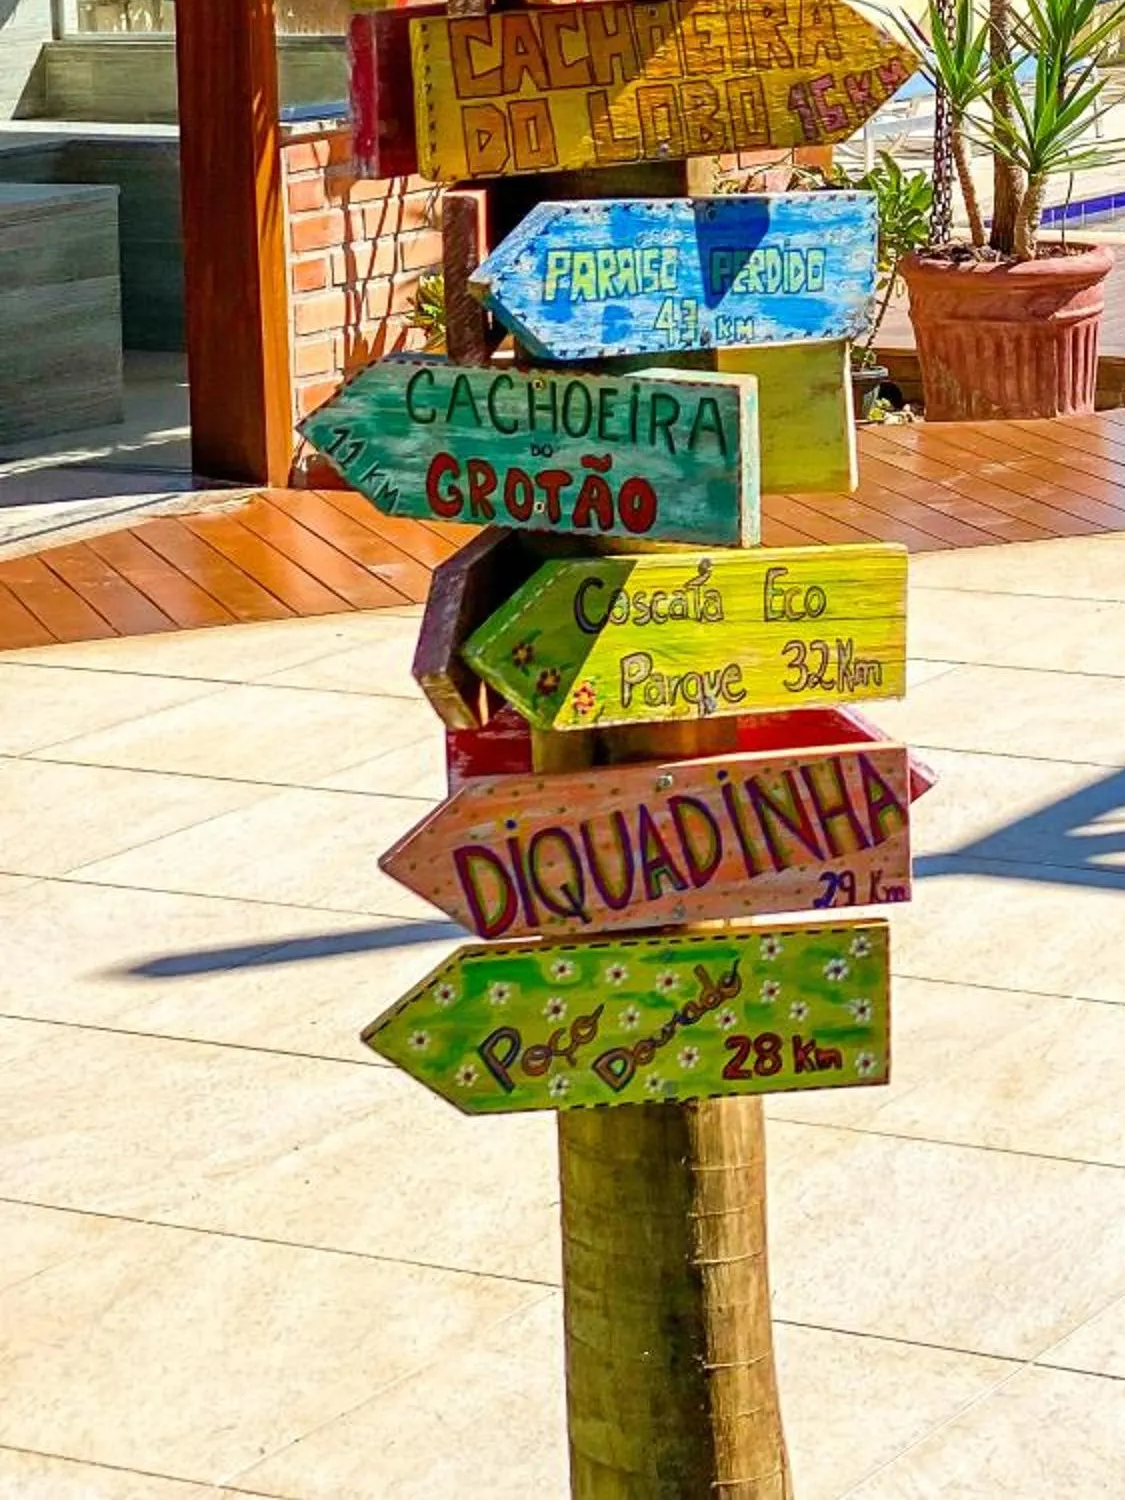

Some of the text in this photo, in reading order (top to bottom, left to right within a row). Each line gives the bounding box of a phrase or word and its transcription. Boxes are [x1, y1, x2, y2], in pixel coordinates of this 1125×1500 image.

[461, 75, 772, 177] DO LOBO
[715, 313, 755, 341] KM
[405, 367, 729, 459] CACHOEIRA
[530, 443, 554, 459] DO
[358, 460, 401, 515] KM
[425, 451, 658, 534] GROTÃO
[763, 566, 827, 623] Eco
[619, 650, 747, 714] Parque
[813, 869, 857, 908] 29
[721, 1033, 784, 1080] 28
